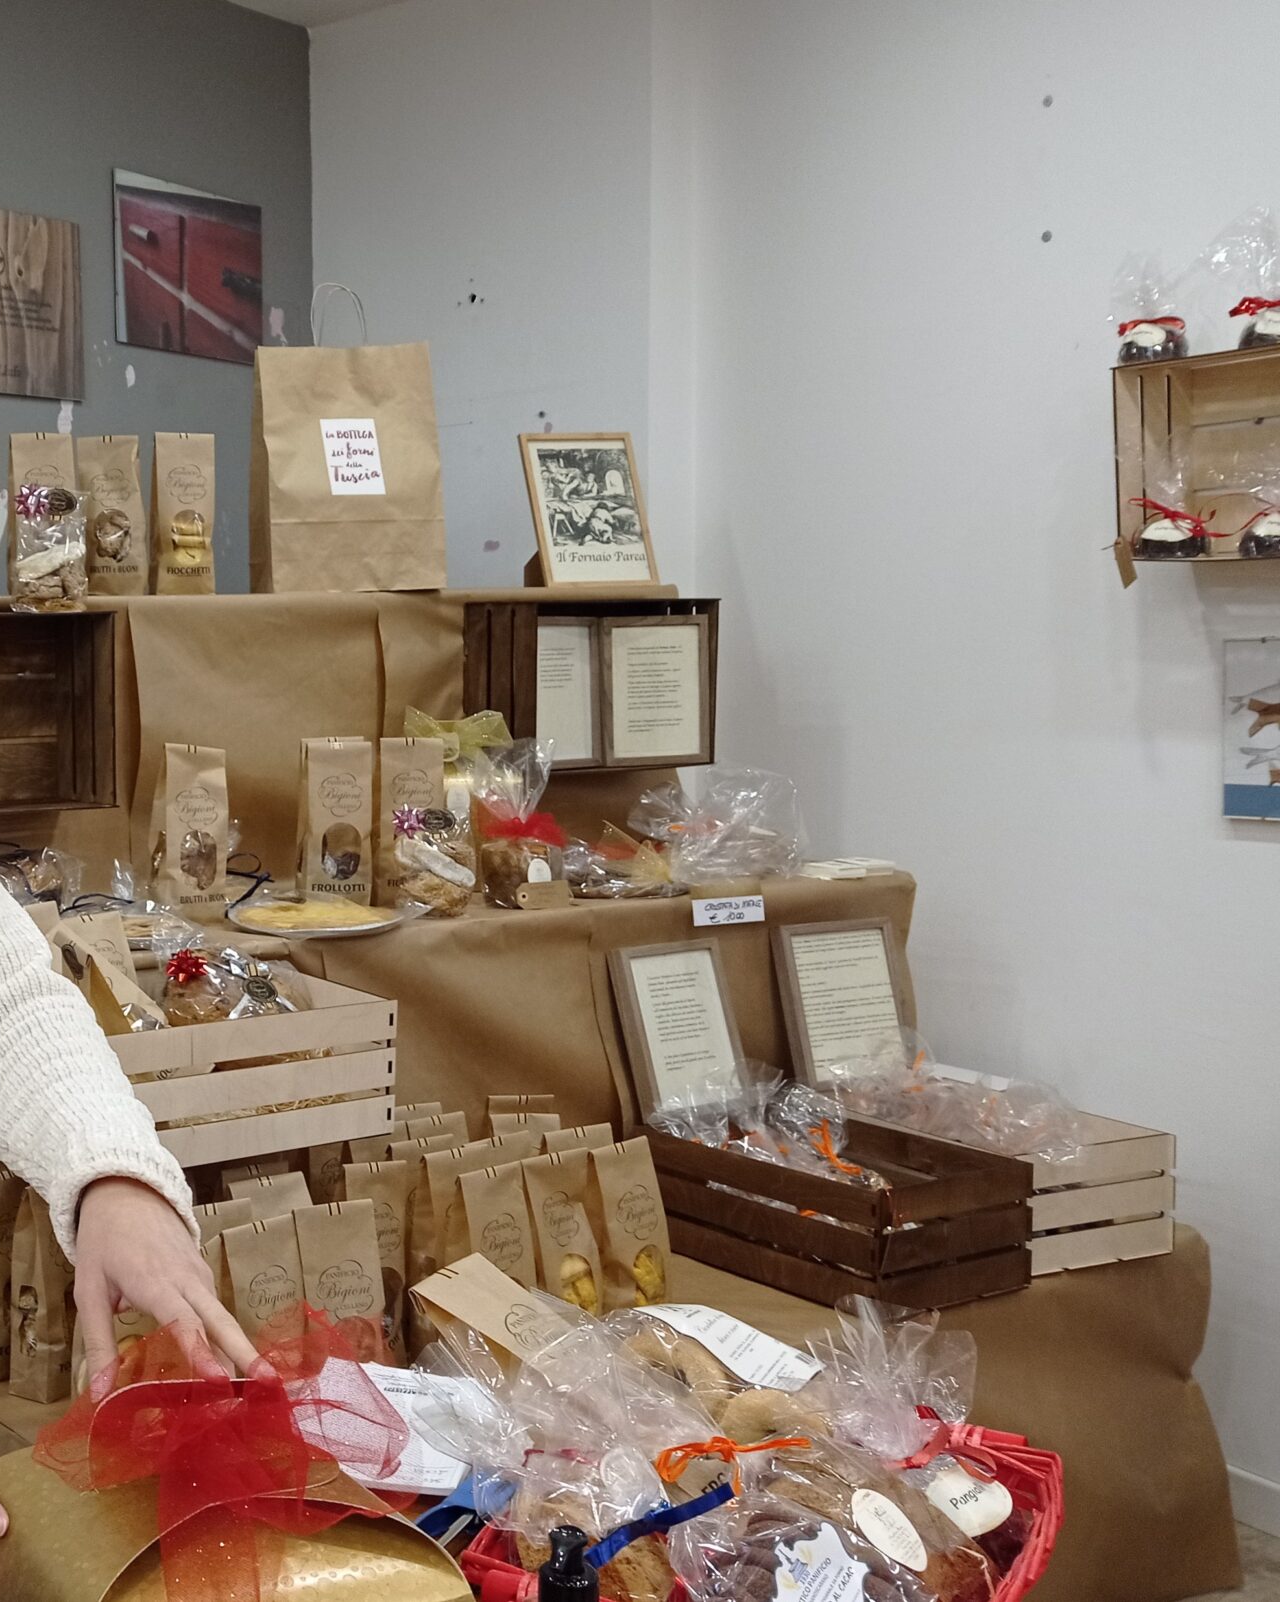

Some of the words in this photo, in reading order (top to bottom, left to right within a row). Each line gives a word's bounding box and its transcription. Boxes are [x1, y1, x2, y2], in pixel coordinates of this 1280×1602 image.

[336, 429, 375, 440] BOTTEGA
[330, 464, 381, 484] Tuscia
[568, 551, 613, 563] Fornaio
[167, 565, 211, 576] FIOCCHETTI
[311, 883, 366, 893] FROLLOTTI
[180, 895, 204, 905] BRUTTI
[324, 1281, 372, 1303] Bigioni
[256, 1289, 296, 1309] Bigioni
